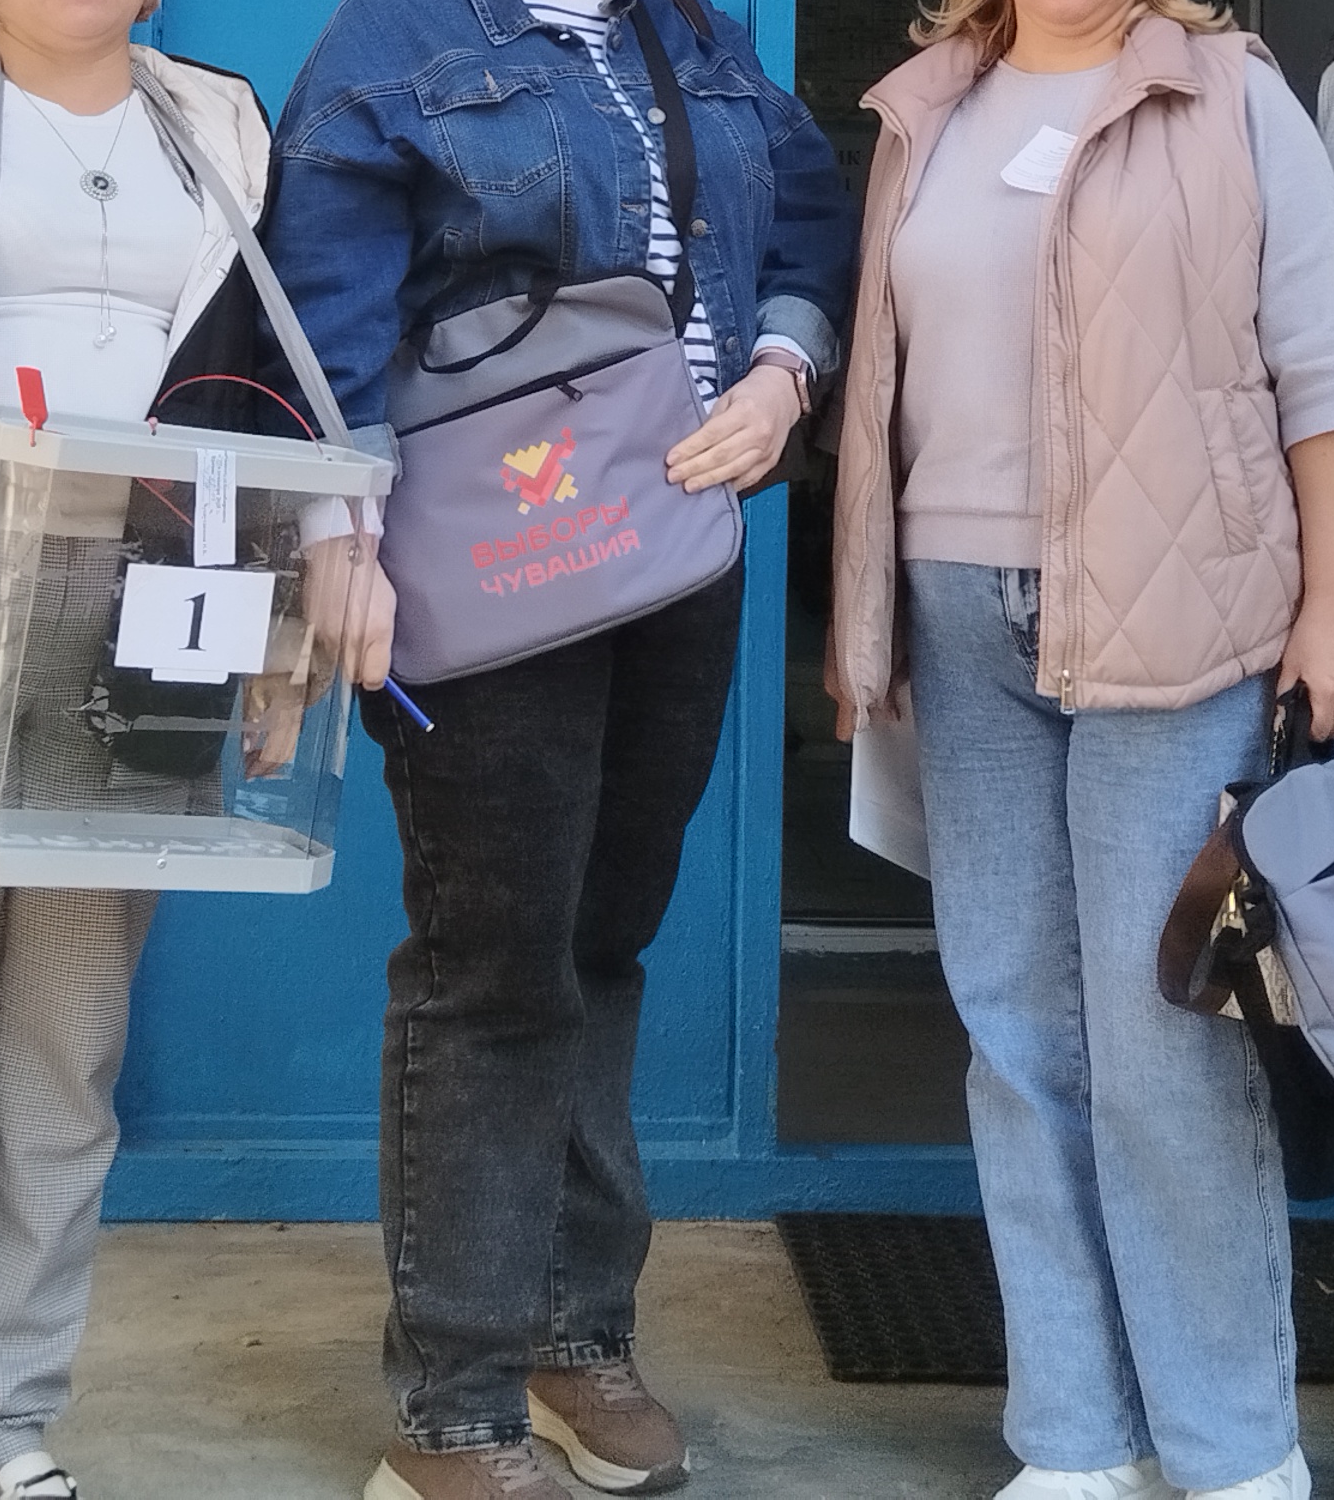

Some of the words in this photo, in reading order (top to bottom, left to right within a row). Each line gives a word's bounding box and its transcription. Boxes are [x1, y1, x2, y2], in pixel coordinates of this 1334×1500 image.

[470, 495, 630, 569] ВЫБОРЫ
[479, 528, 641, 598] ЧУВАШИЯ
[178, 591, 207, 652] 1
